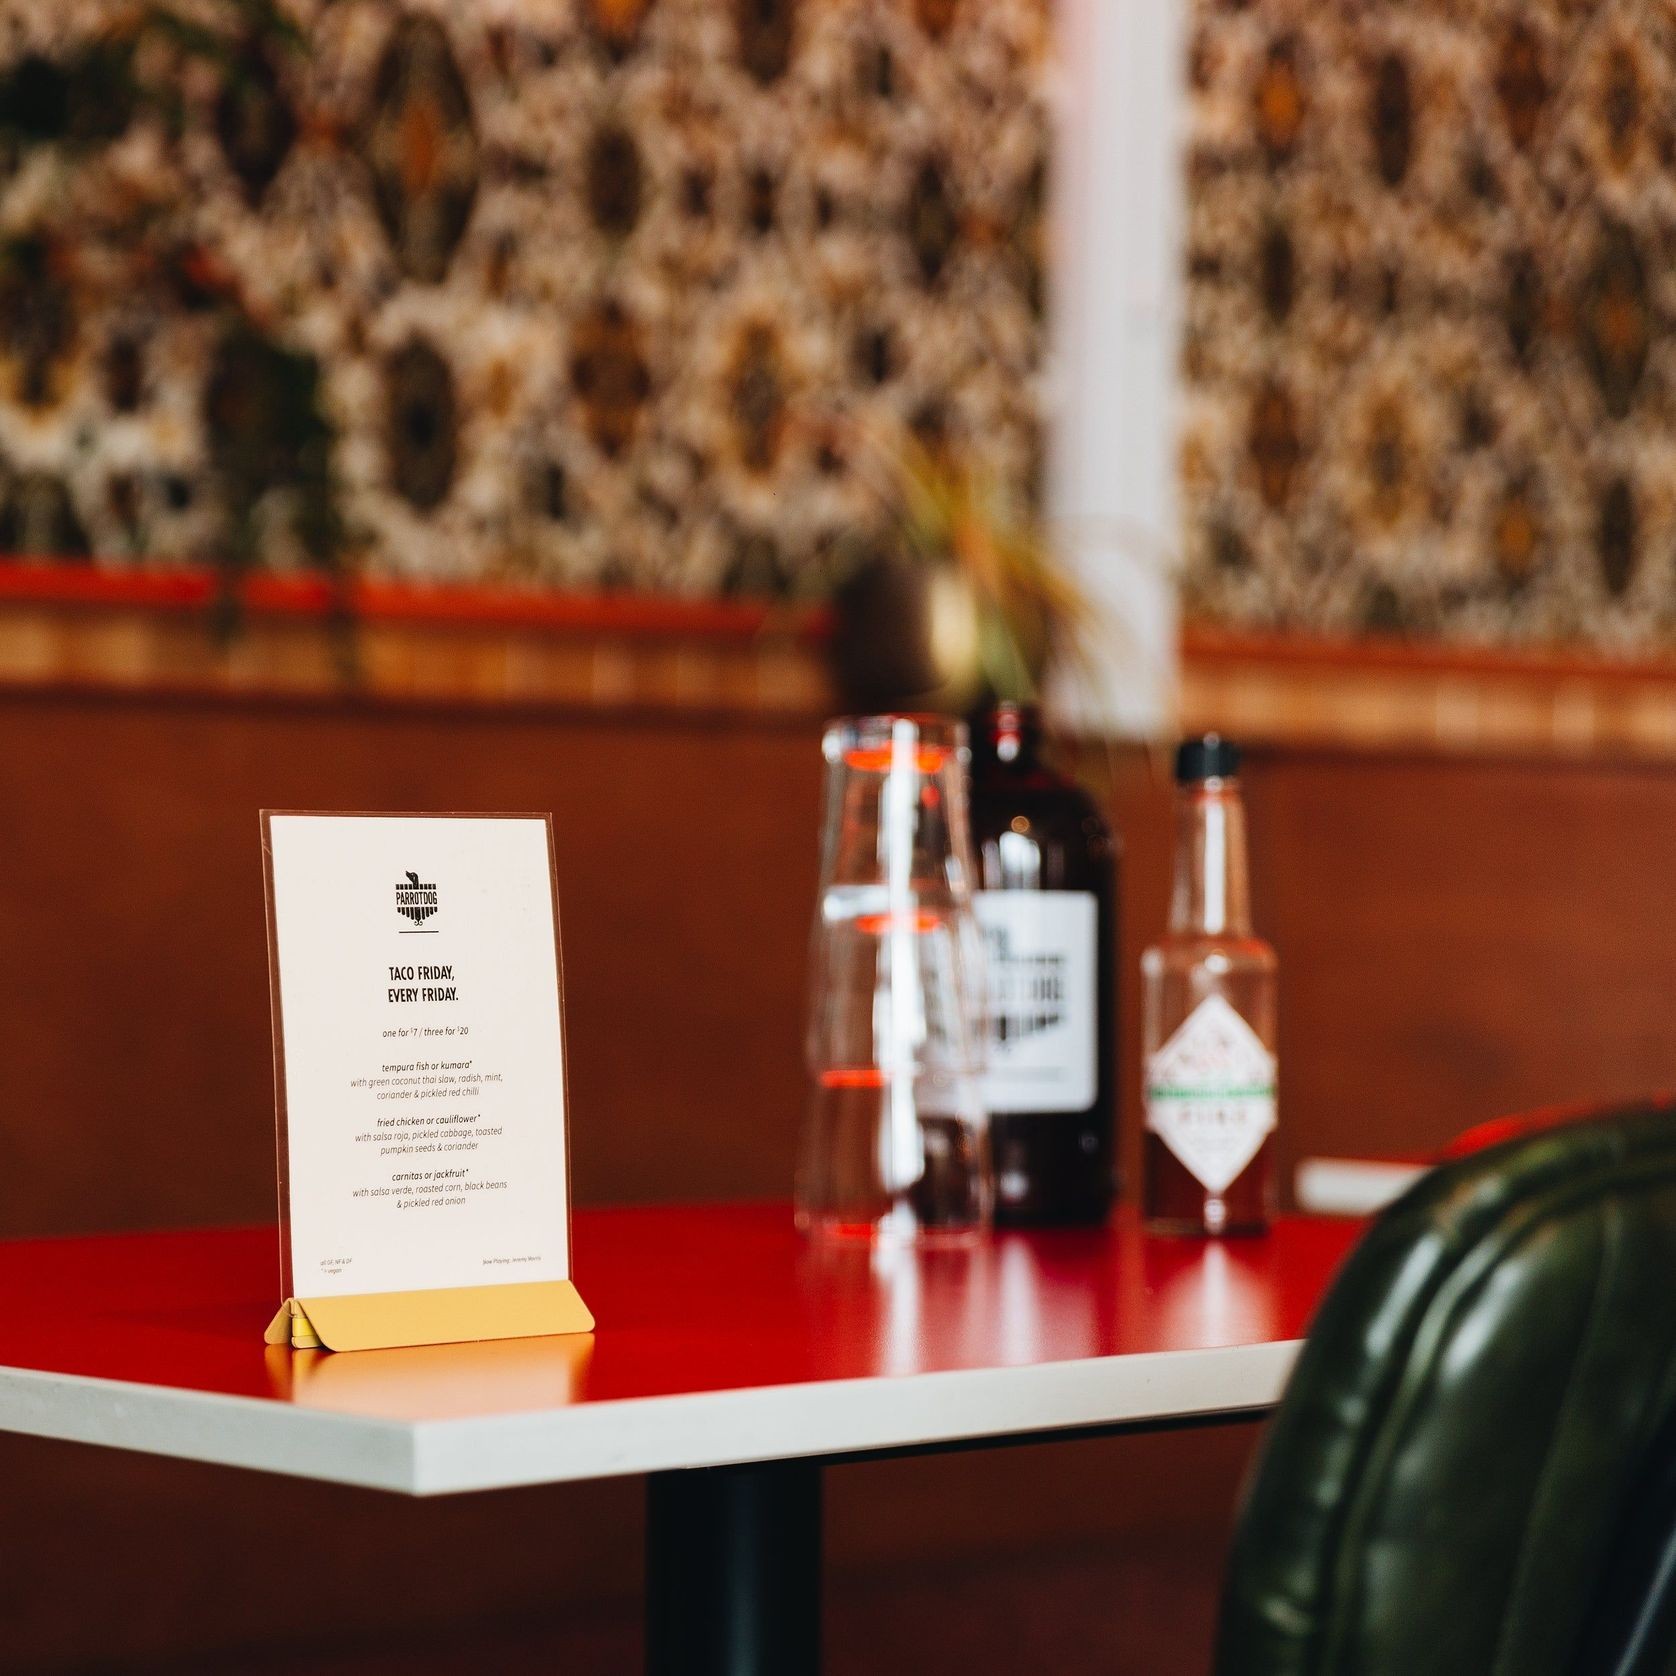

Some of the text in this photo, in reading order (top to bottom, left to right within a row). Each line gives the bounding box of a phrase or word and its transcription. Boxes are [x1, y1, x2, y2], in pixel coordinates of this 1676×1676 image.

[396, 891, 438, 905] PARROTDOG
[389, 965, 455, 981] TACO FRIDAY,
[388, 987, 458, 1002] EVERY FRIDAY.
[382, 1029, 397, 1037] one
[398, 1028, 409, 1037] for
[424, 1027, 444, 1037] three
[445, 1027, 455, 1036] for
[382, 1064, 414, 1073] tempura
[416, 1061, 429, 1071] fish
[350, 1073, 503, 1089] with green coconut thai slaw, radish, mint,
[377, 1086, 479, 1100] coriander & pickled red chilli
[377, 1117, 395, 1128] fried
[396, 1116, 425, 1126] chicken
[426, 1117, 435, 1125] or
[355, 1126, 503, 1142] with salsa roja, pickled cabbage, toasted
[380, 1141, 479, 1156] pumpkin seeds & coriander
[392, 1172, 423, 1181] carnitas
[424, 1172, 432, 1180] or
[352, 1180, 508, 1197] with salsa verde, roasted corn, black beans
[396, 1196, 466, 1209] & pickled red onion
